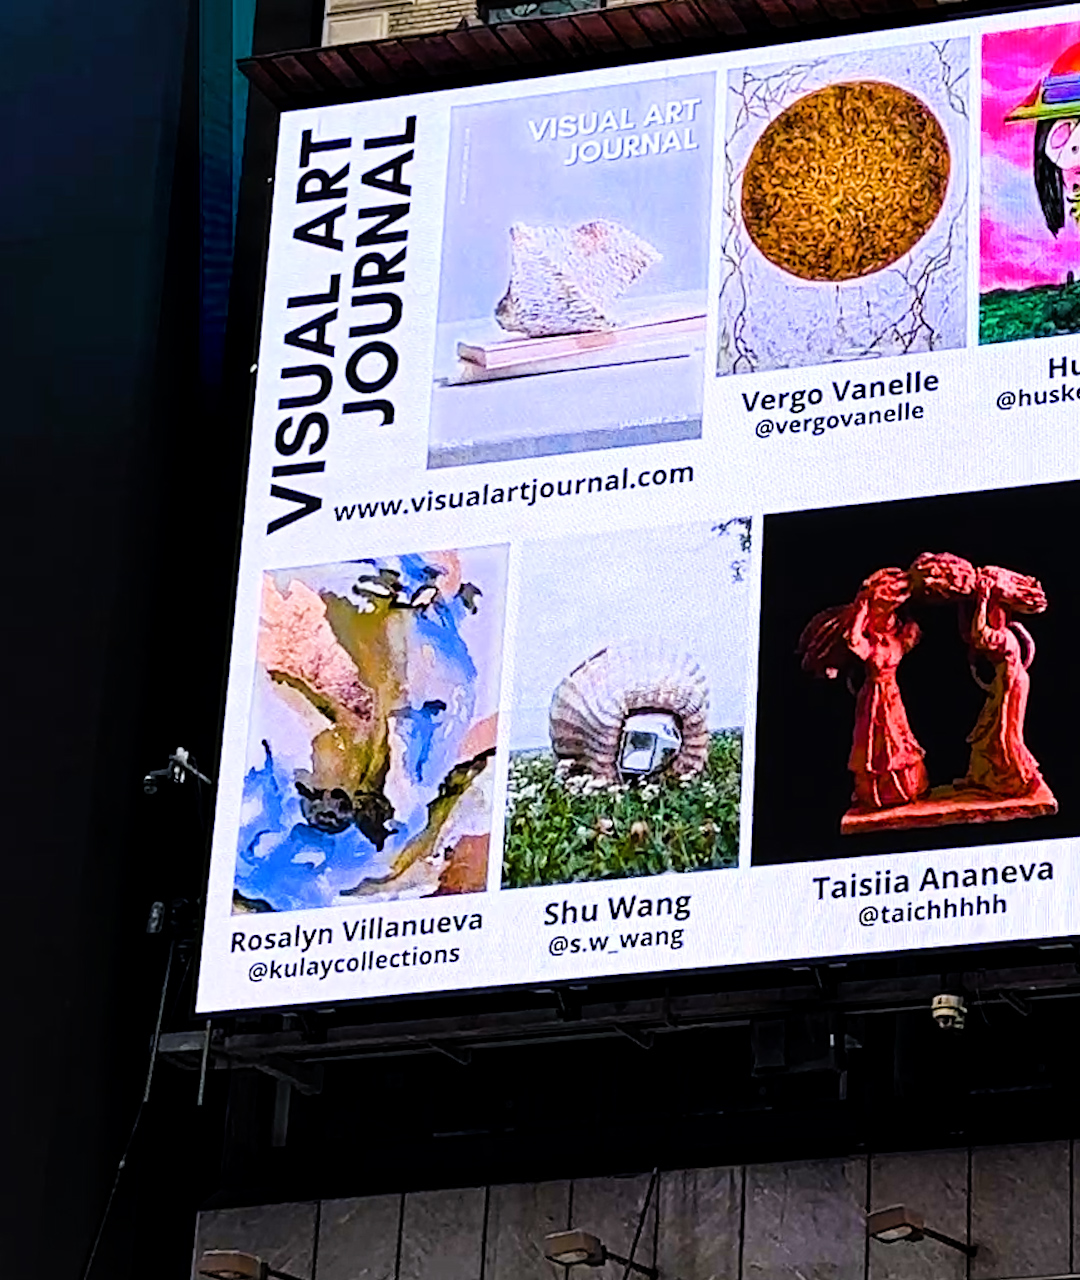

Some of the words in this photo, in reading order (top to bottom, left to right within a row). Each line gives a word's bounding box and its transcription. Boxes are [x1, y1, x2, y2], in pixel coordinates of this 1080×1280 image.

[527, 107, 636, 142] VISUAL
[642, 97, 702, 128] ART
[563, 127, 700, 166] JOURNAL
[293, 129, 352, 252] ART
[342, 115, 417, 426] JOURNAL
[267, 273, 341, 535] VISUAL
[741, 384, 824, 413] Vergo
[833, 370, 940, 403] Vanelle
[754, 401, 925, 439] @vergovanelle
[334, 461, 695, 522] www.visualartjournal.com
[813, 874, 909, 901] Taisiia
[919, 860, 1054, 892] Ananeva
[543, 901, 598, 926] Shu
[607, 892, 692, 922] Wang
[858, 893, 1007, 927] @taichhhhh
[230, 923, 333, 955] Rosalyn
[341, 910, 483, 943] Villanueva
[548, 925, 684, 957] @s.w_wang
[247, 945, 460, 983] @kulaycollections
